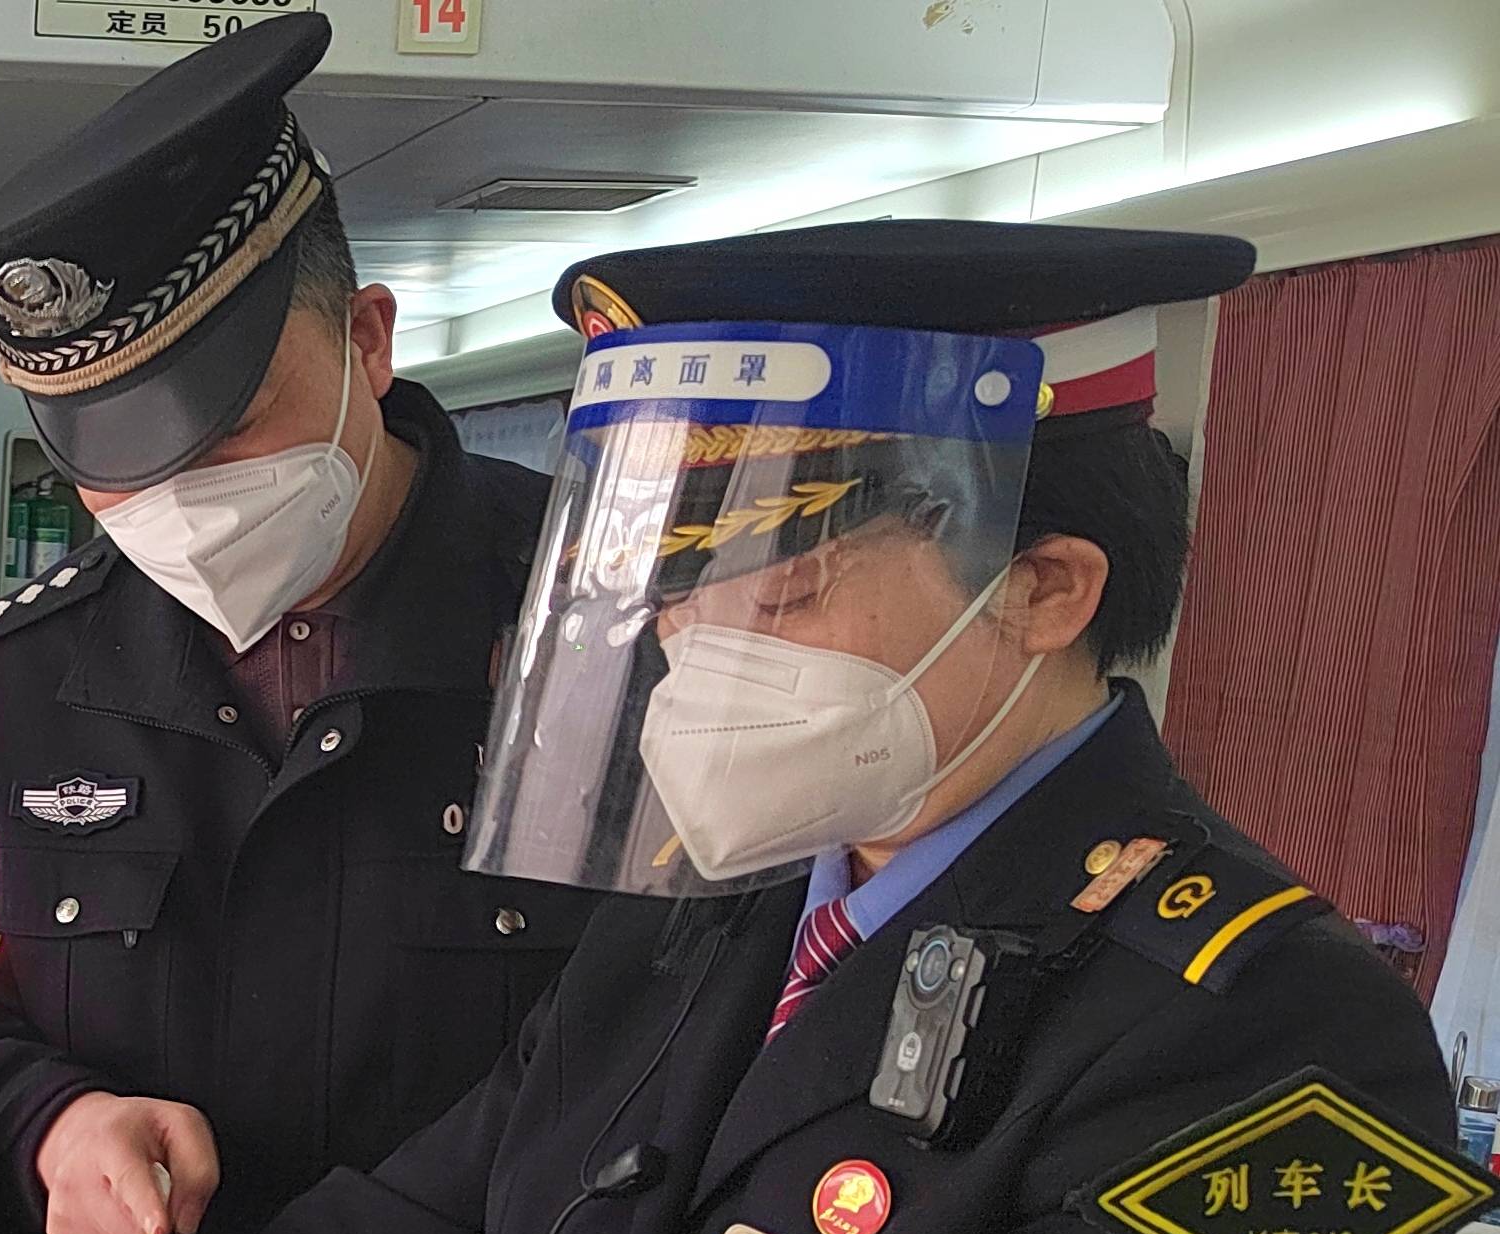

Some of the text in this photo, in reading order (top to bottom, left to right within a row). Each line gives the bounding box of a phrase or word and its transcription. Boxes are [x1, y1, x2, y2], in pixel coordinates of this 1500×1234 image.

[106, 11, 167, 36] 定员
[412, 0, 466, 33] 14
[855, 748, 891, 767] N95
[60, 798, 93, 806] POLICE
[1202, 1160, 1392, 1216] 列车长
